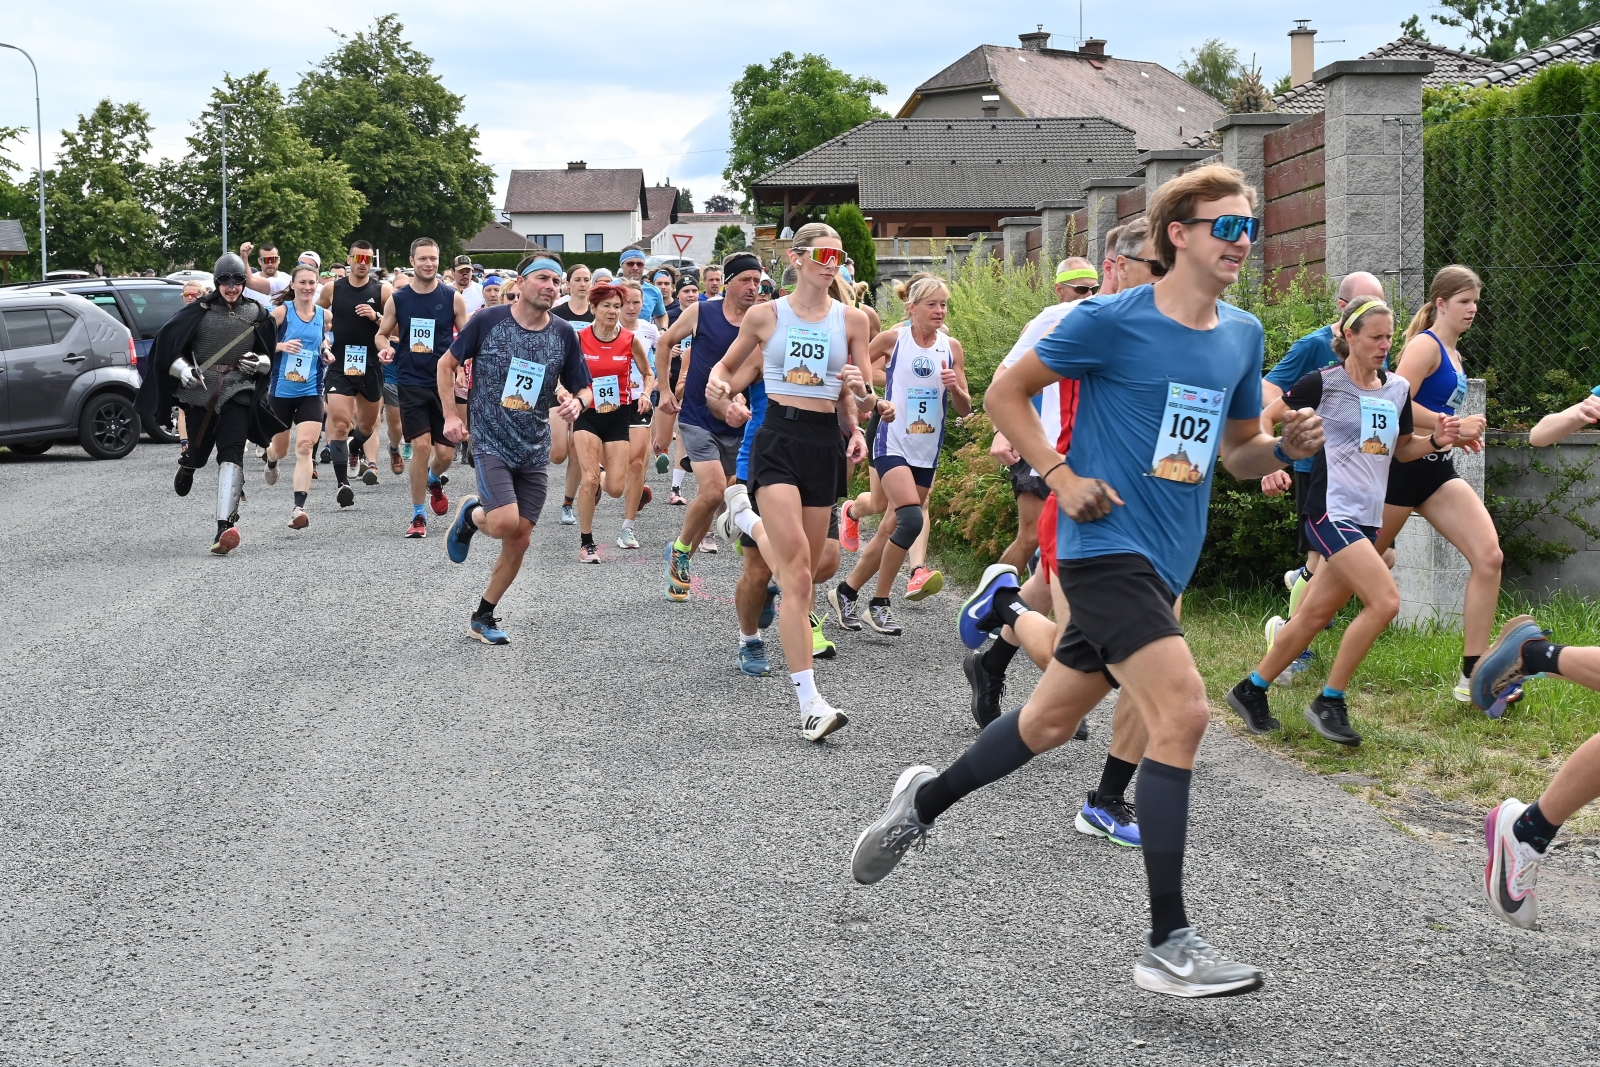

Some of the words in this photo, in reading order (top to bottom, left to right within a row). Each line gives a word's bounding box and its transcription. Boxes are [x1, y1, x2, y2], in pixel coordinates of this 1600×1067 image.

[413, 329, 430, 338] 109
[790, 342, 824, 359] 203
[295, 358, 303, 367] 3
[346, 354, 364, 363] 244
[515, 374, 534, 390] 73
[599, 386, 614, 398] 84
[918, 401, 927, 414] 5
[1371, 413, 1387, 429] 13
[1169, 413, 1210, 443] 102
